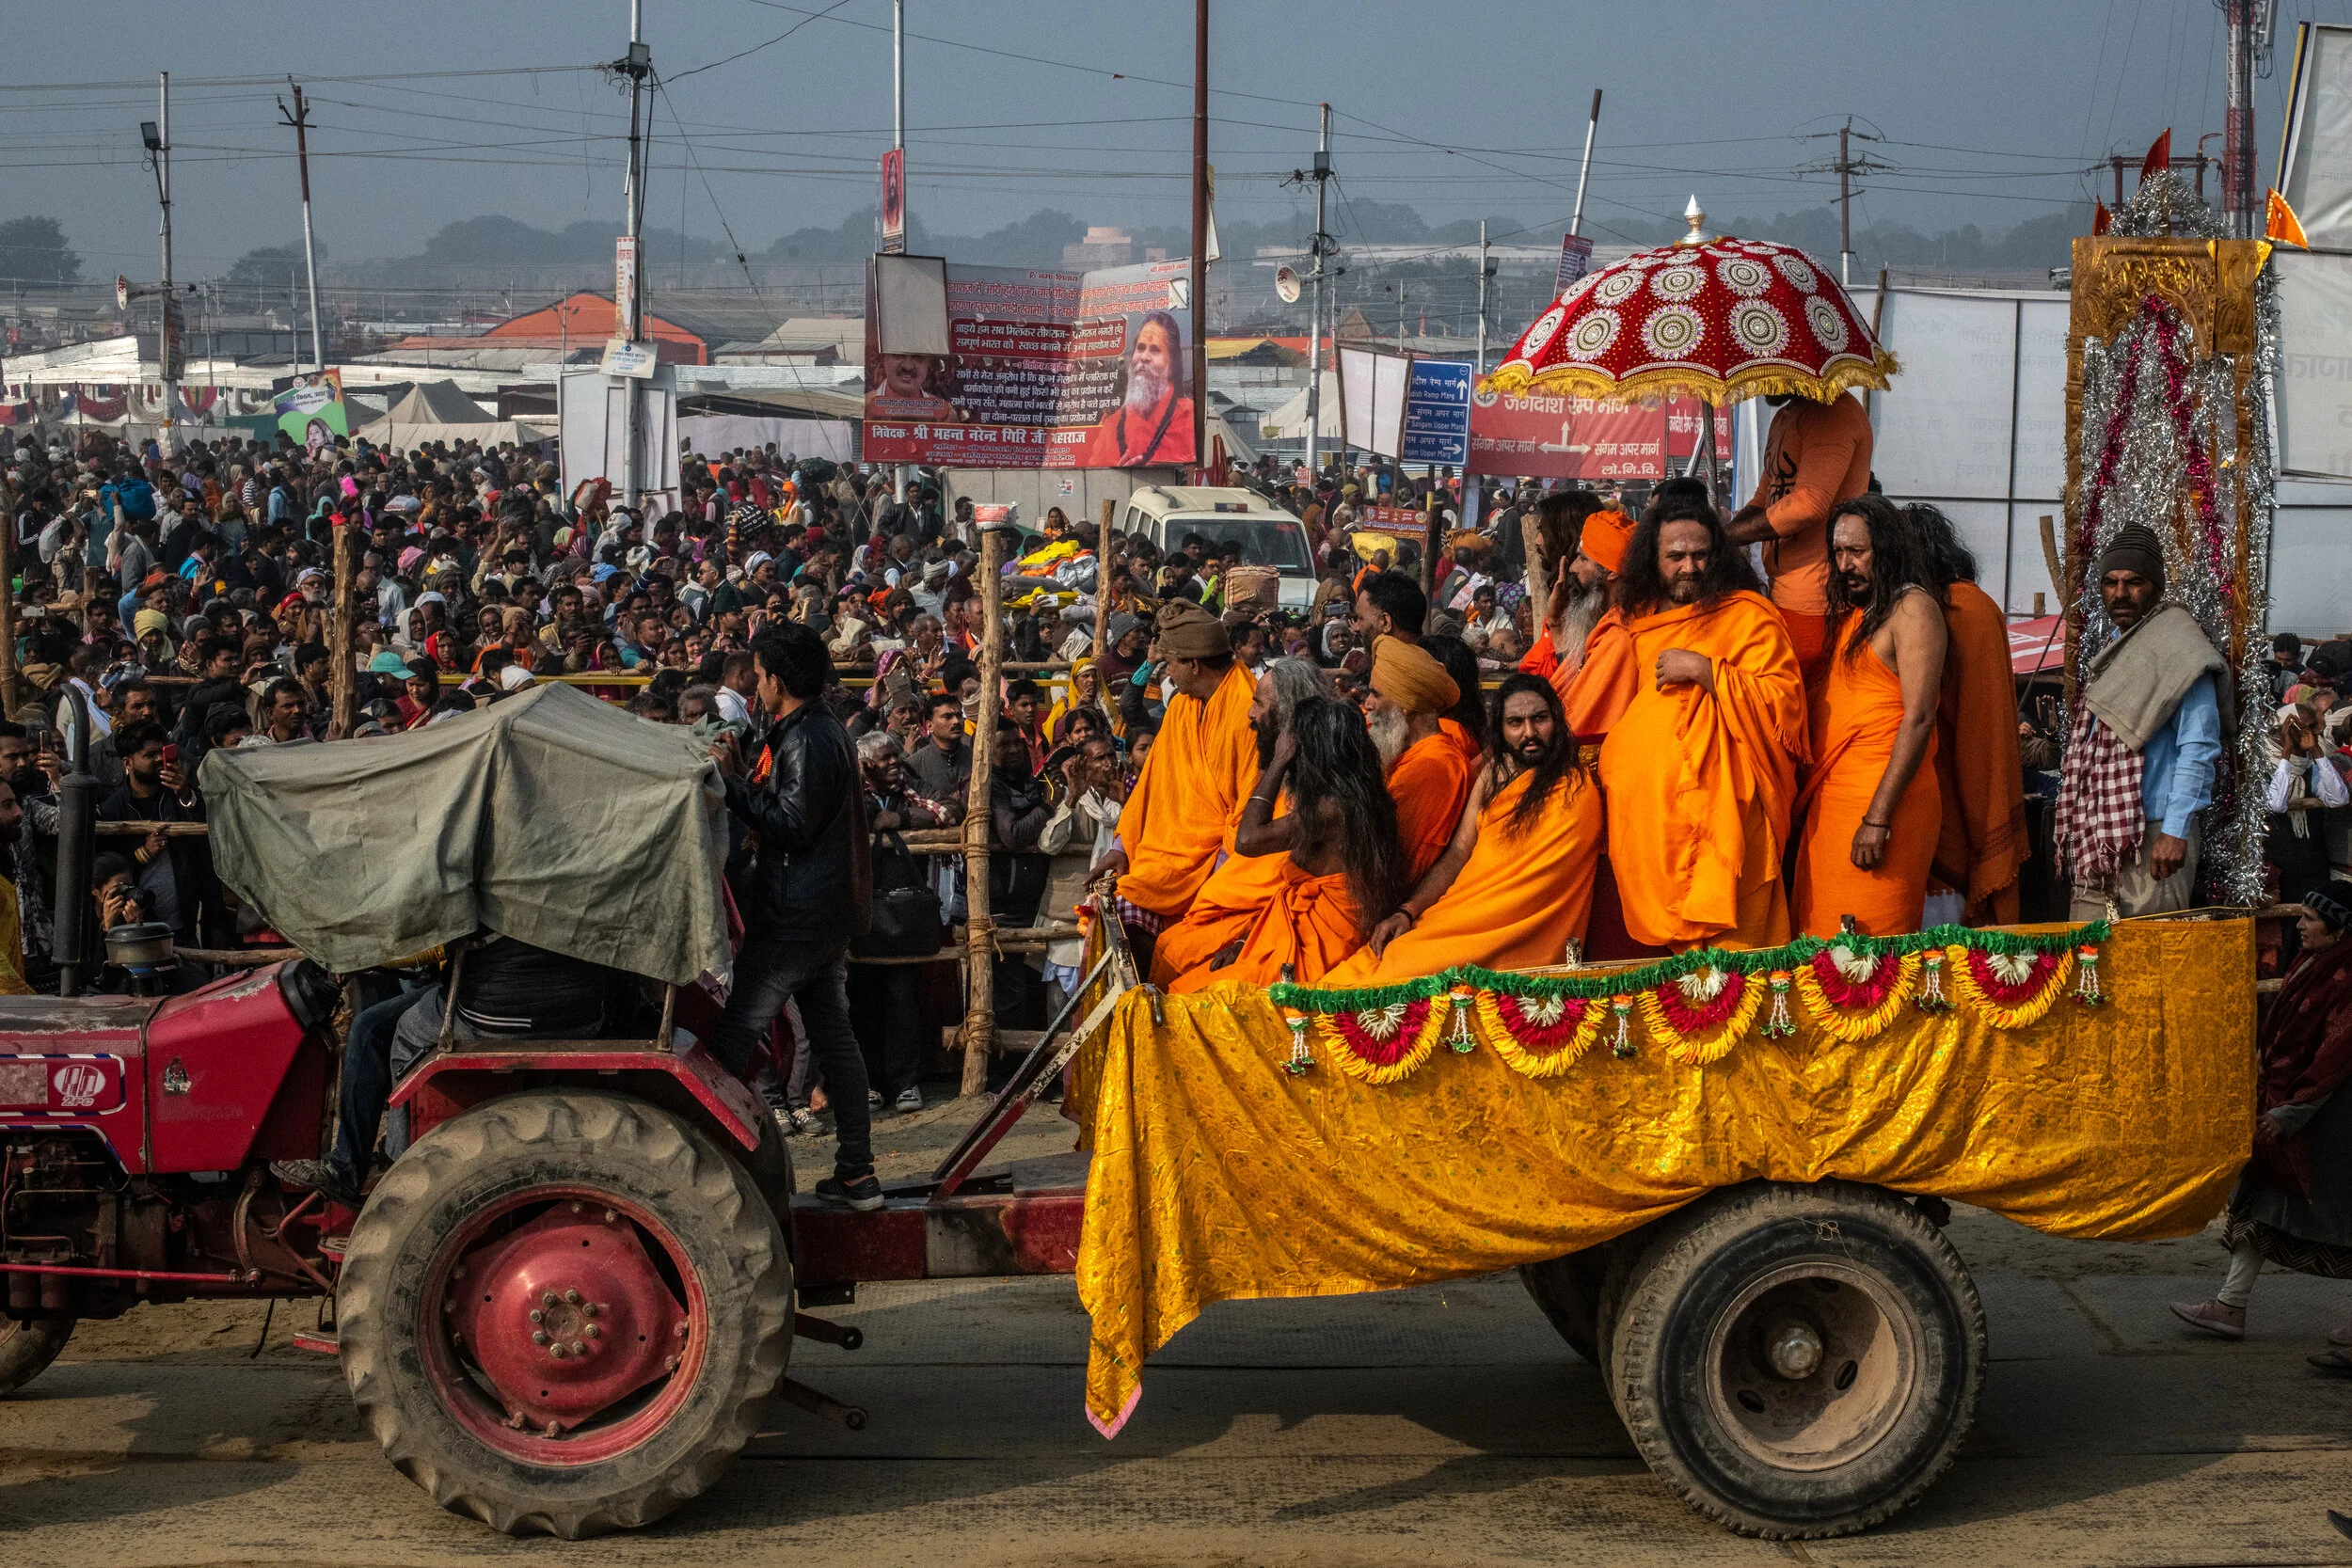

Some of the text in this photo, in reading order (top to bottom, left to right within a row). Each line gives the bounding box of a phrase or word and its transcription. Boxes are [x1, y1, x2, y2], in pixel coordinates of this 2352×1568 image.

[975, 280, 984, 294] में
[985, 280, 1001, 295] आये
[1067, 287, 1076, 301] के
[973, 301, 997, 314] स्वरूप
[1046, 303, 1059, 317] एवं
[977, 325, 990, 335] हम
[992, 325, 1005, 336] सब
[1006, 324, 1036, 338] मिलकर
[956, 336, 980, 351] सम्पूर्ण
[981, 339, 1001, 350] भारत
[1003, 338, 1014, 350] को
[1018, 341, 1040, 351] स्वच्छ
[1041, 341, 1061, 352] बनाने
[1063, 341, 1073, 353] में
[1088, 339, 1108, 351] सहयोग
[1110, 337, 1121, 349] करें
[956, 368, 971, 379] सभी
[973, 369, 979, 380] से
[980, 369, 993, 380] मेरा
[995, 371, 1019, 384] अनुरोध
[1020, 371, 1026, 383] है
[1027, 371, 1037, 382] कि
[1110, 369, 1119, 381] एवं
[1445, 377, 1457, 389] मार्ग
[993, 384, 1005, 395] की
[1005, 385, 1019, 396] बनी
[1050, 386, 1059, 397] भी
[1080, 385, 1097, 397] प्रयोग
[1103, 383, 1114, 394] करें
[1441, 391, 1454, 401] Marg
[950, 395, 965, 406] सभी
[967, 397, 981, 410] पूज्य
[999, 399, 1023, 410] महात्मा
[1024, 399, 1035, 410] एवं
[980, 411, 992, 423] हुए
[1033, 412, 1042, 423] एवं
[1069, 412, 1086, 423] प्रयोग
[1087, 410, 1098, 421] करें
[1417, 408, 1466, 420] संगम अपर मार्ग
[1411, 420, 1465, 433] Sangam Upper Marg
[914, 424, 930, 440] श्री
[933, 427, 965, 442] महन्त
[969, 427, 997, 444] नरेन्द्र
[1002, 427, 1027, 444] गिरि
[1030, 428, 1046, 445] जी
[1050, 431, 1087, 446] महाराज
[1419, 436, 1436, 446] अपर
[1439, 436, 1453, 447] मार्ग
[1471, 433, 1535, 453] संगम अपर मार्ग
[1594, 438, 1660, 456] संगम अपर मार्ग
[1421, 450, 1436, 459] Upper
[1437, 450, 1451, 460] Marg
[1601, 463, 1660, 476] लो.नि.वि.
